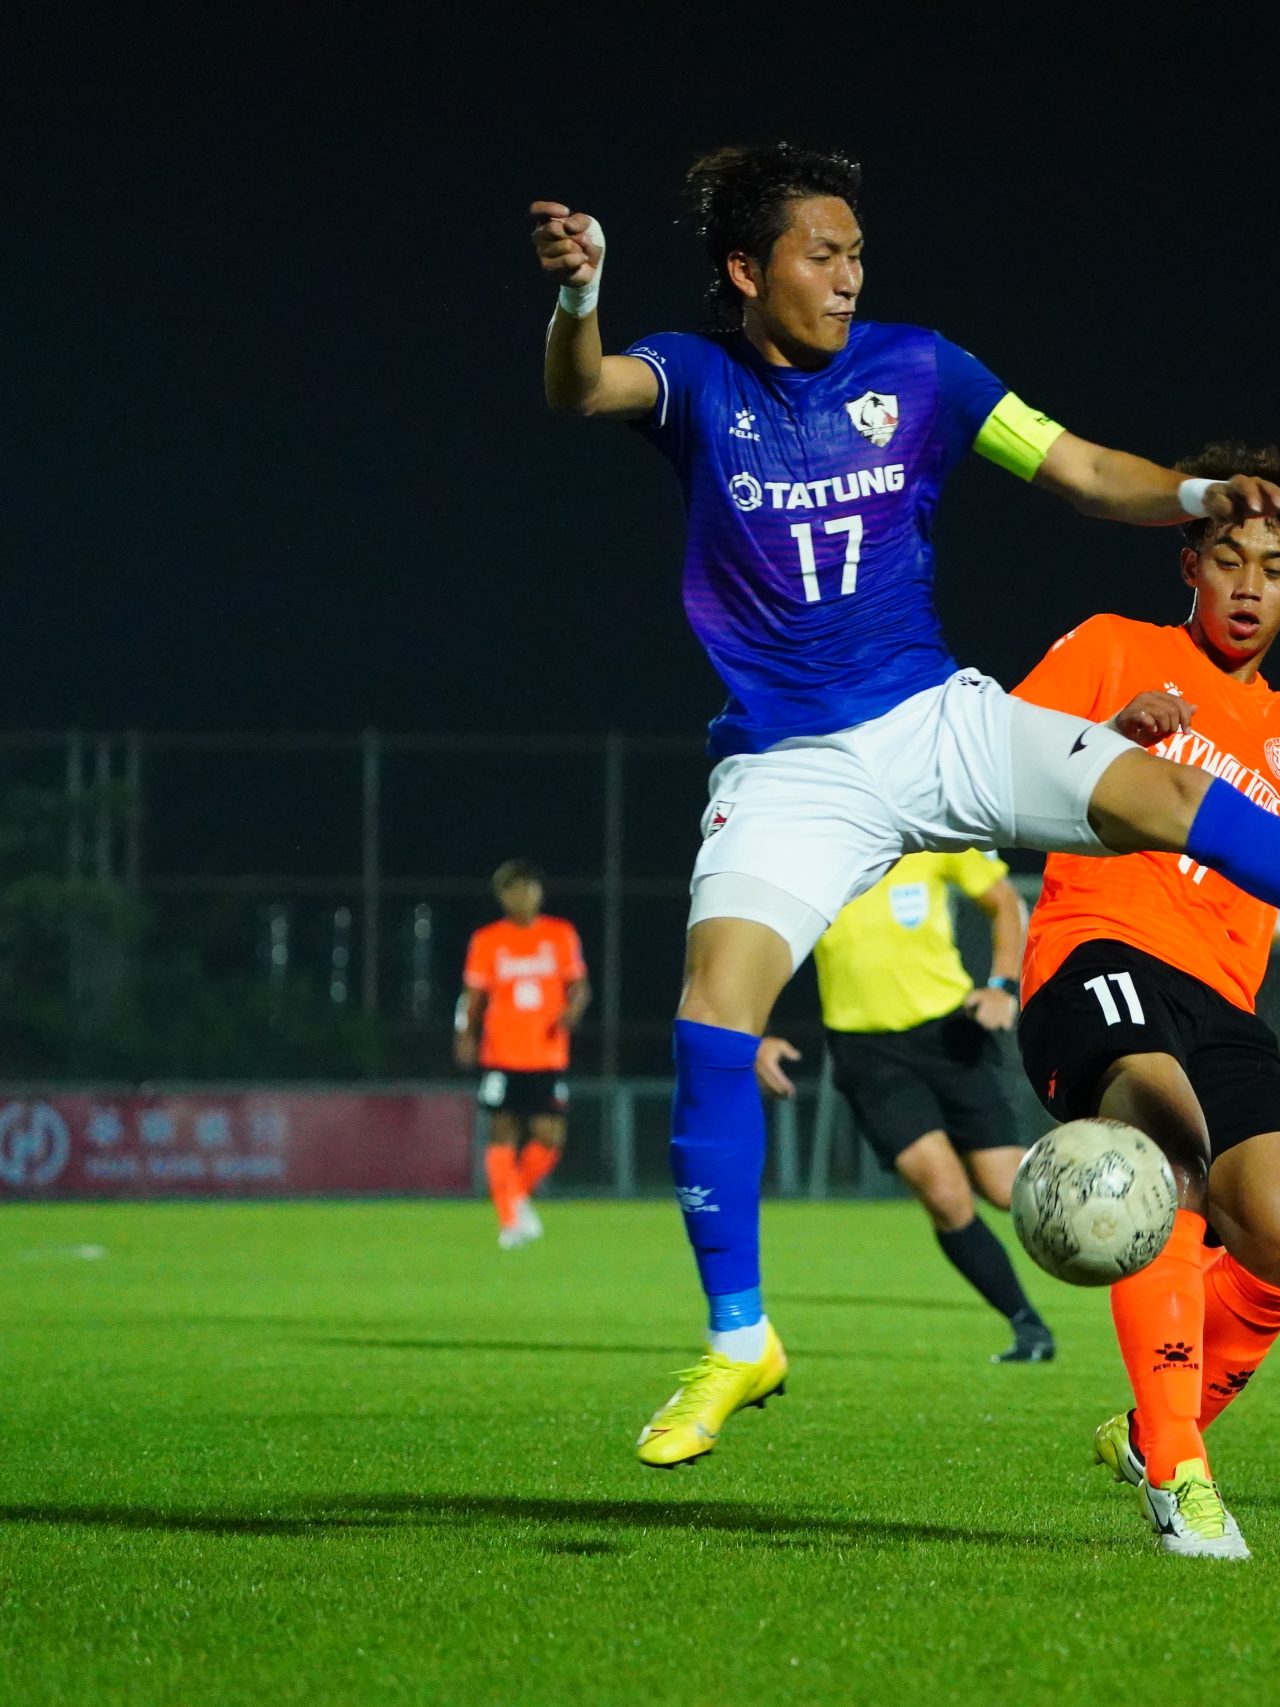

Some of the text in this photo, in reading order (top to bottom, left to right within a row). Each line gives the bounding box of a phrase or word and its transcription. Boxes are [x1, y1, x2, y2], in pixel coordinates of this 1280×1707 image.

[764, 463, 905, 510] TATUNG
[790, 514, 864, 603] 17
[1083, 971, 1146, 1027] 11
